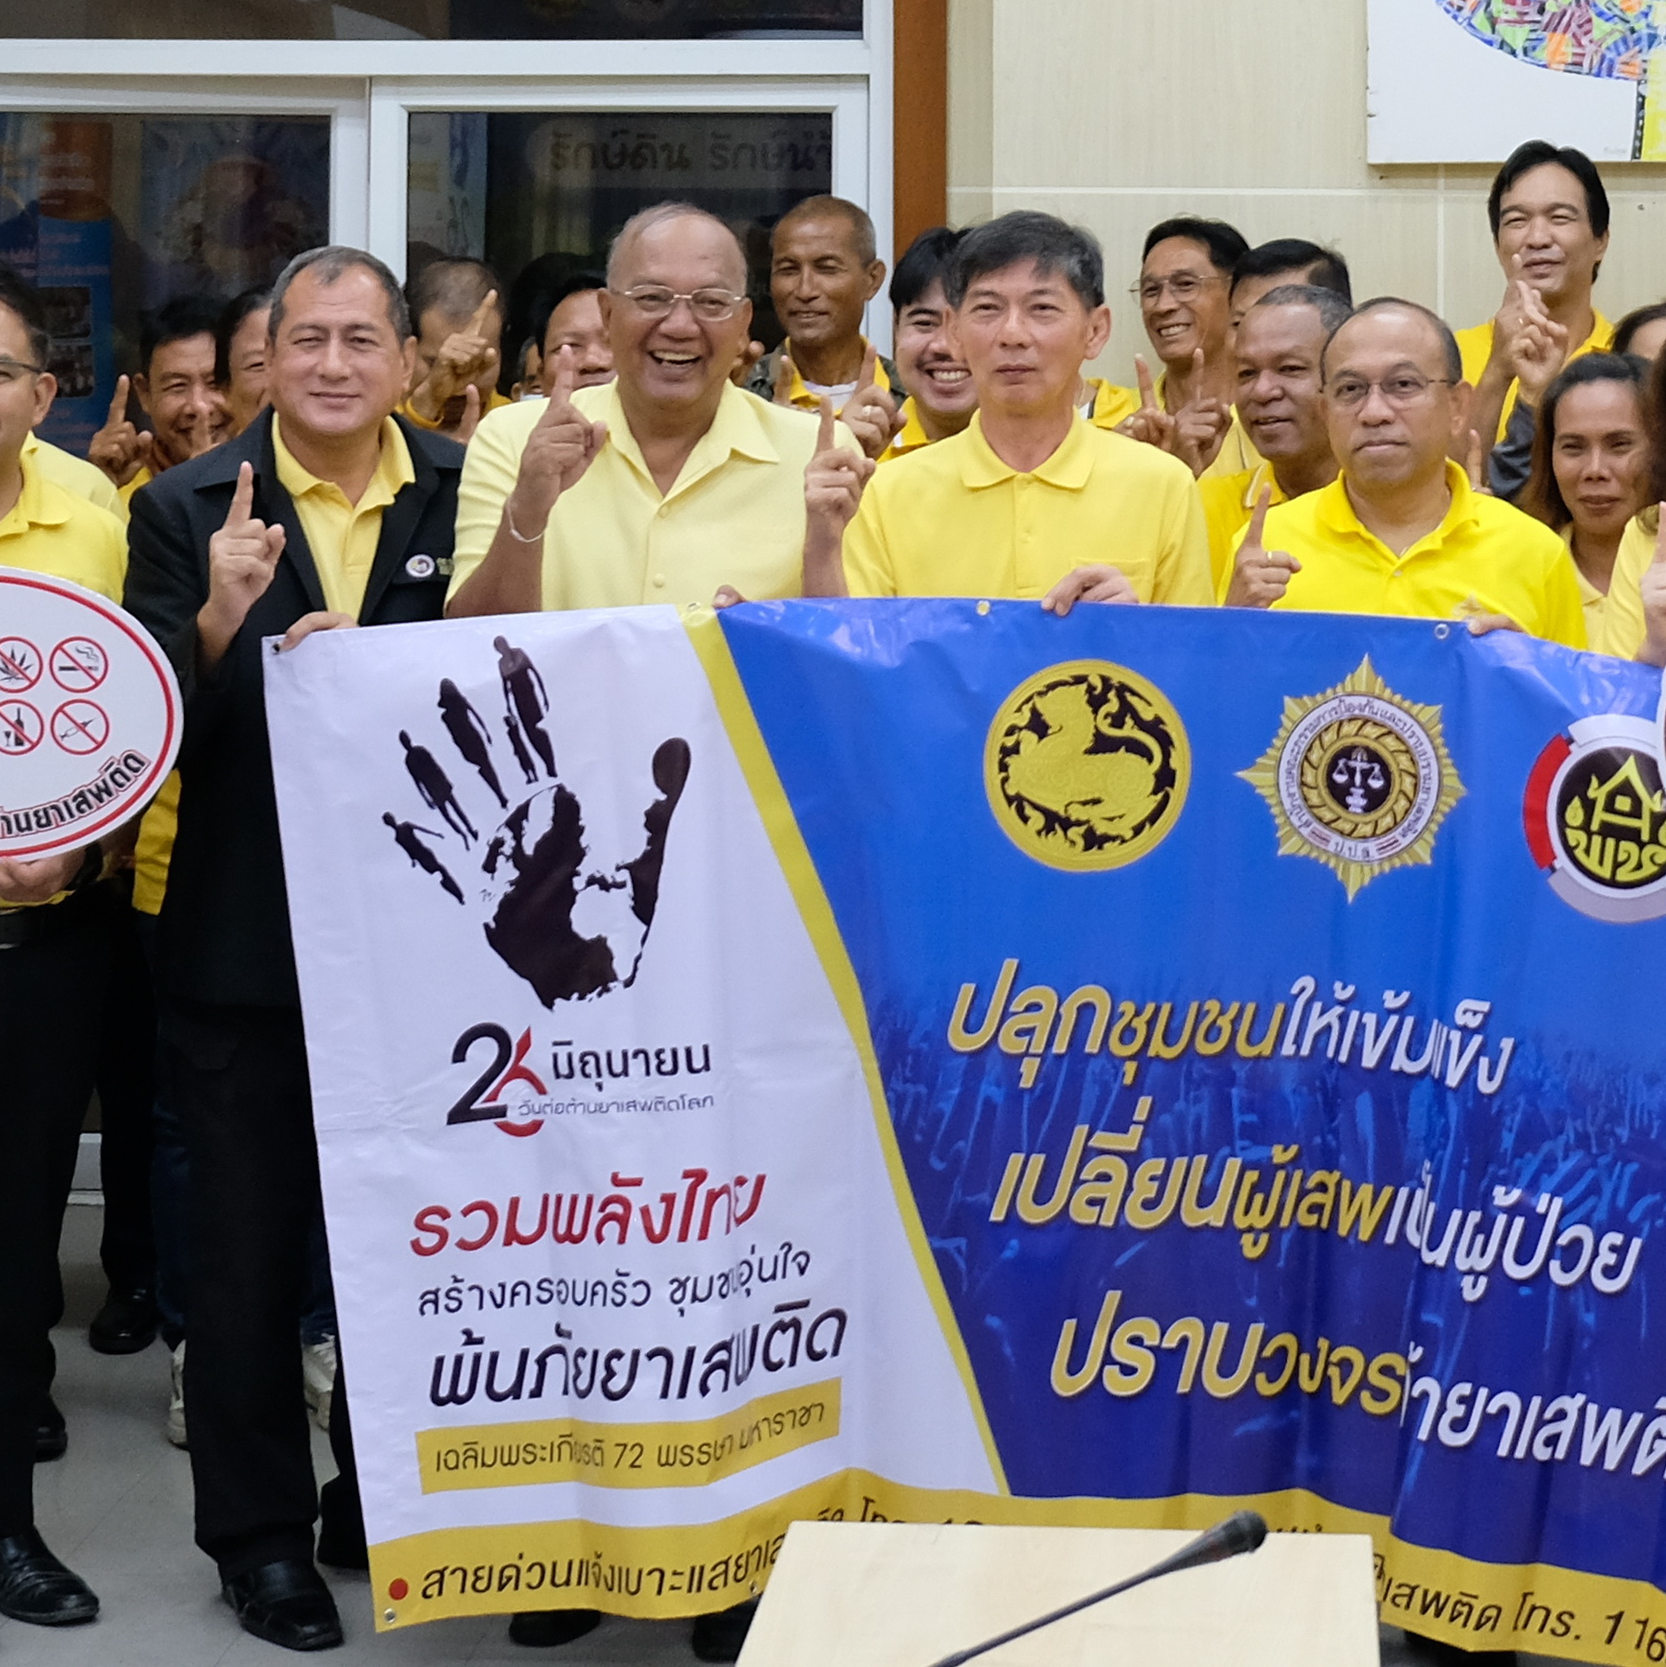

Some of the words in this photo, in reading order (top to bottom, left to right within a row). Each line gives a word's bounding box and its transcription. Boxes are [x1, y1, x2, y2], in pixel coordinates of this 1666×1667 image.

[946, 958, 1516, 1095] ปลุกชุมชนให้เข้มแข็ง
[446, 1022, 548, 1137] 26
[551, 1040, 711, 1091] มิถุนายน
[518, 1094, 714, 1116] วันต่อต้านยาเสพติดโลก
[410, 1168, 767, 1256] รวมพลังไทย
[418, 1268, 652, 1316] สร้างครอบครัว
[669, 1242, 811, 1317] ชุมชอุ่นใจ
[430, 1299, 849, 1407] พ้นภัยยาเสพติด
[436, 1433, 605, 1472] เฉลิมพระเกียรติ
[613, 1443, 644, 1470] 72
[1513, 1592, 1581, 1641] โทร.
